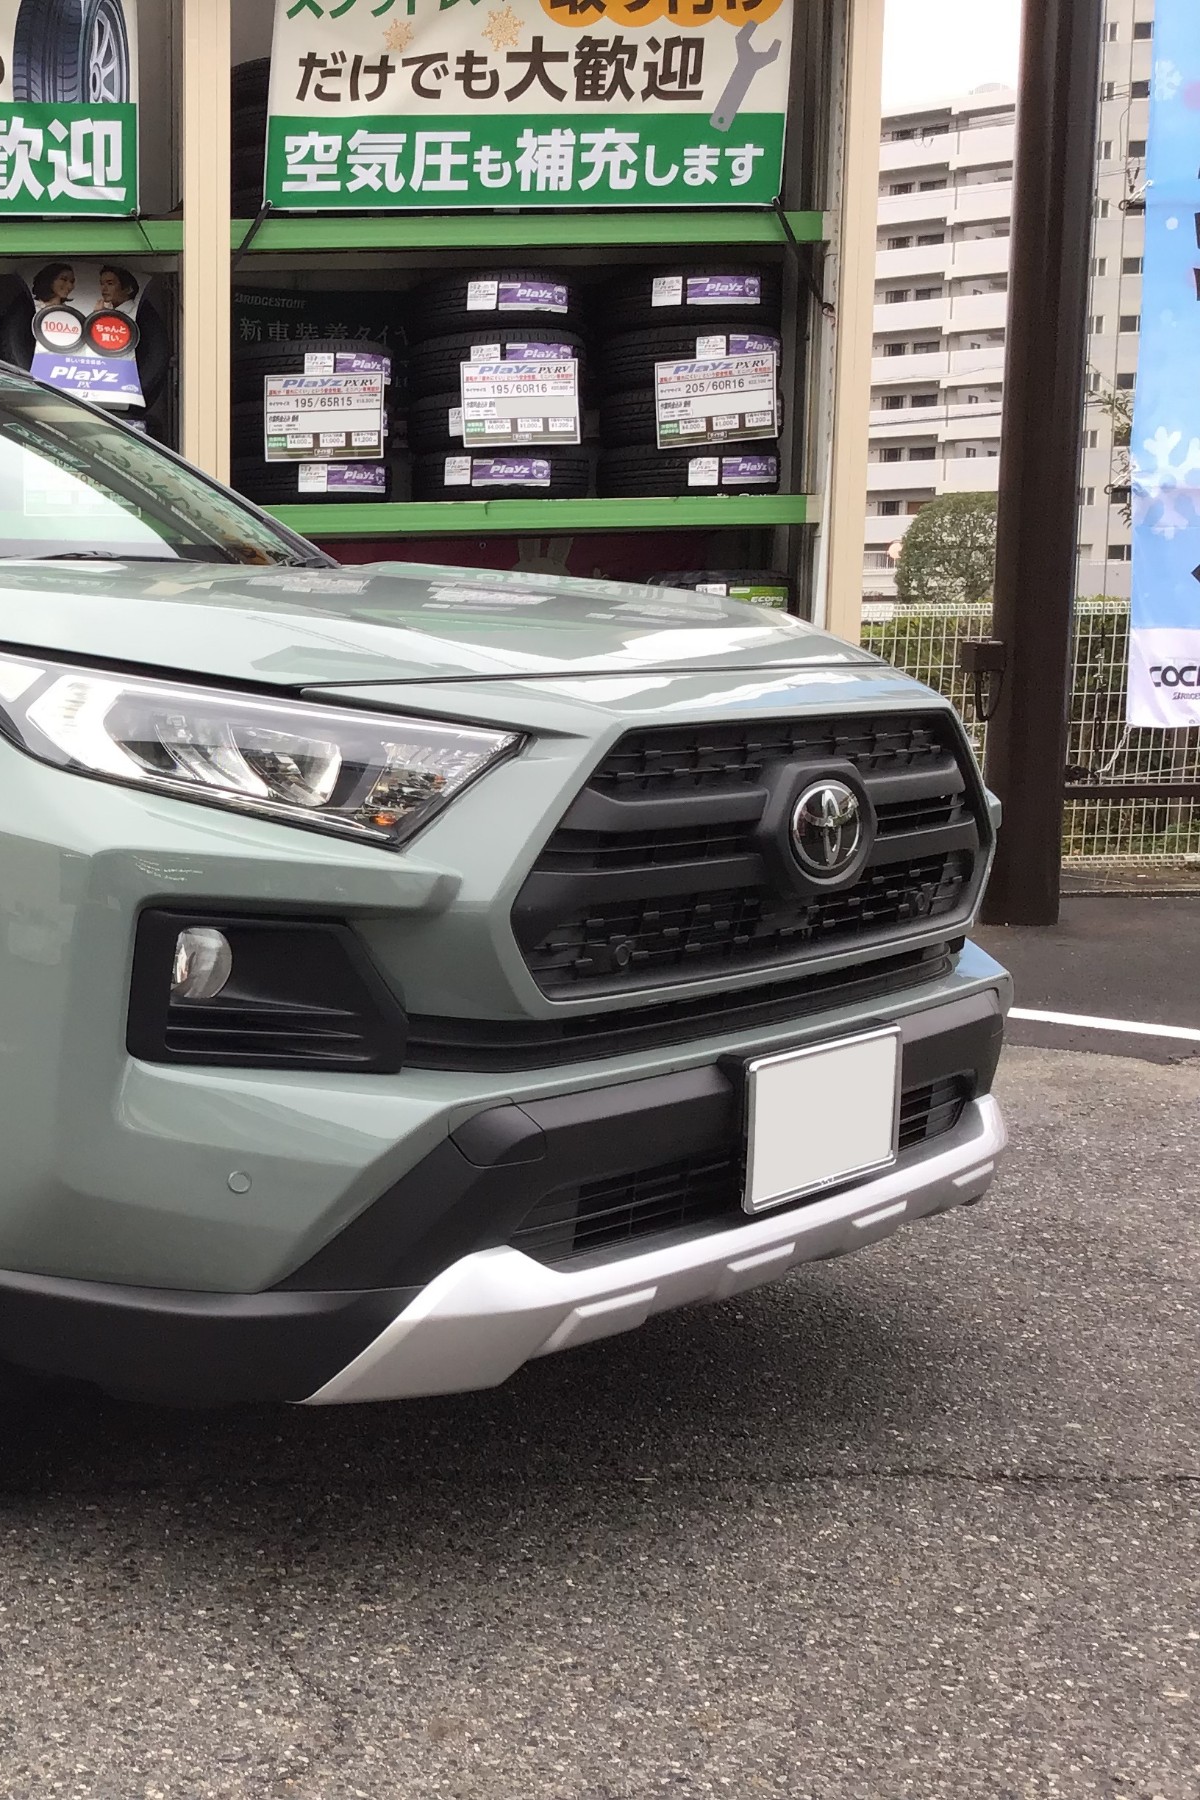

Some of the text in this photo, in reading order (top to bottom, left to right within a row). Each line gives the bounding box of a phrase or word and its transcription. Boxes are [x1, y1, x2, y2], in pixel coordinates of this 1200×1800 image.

[296, 34, 706, 103] だけでも大歓迎
[281, 126, 765, 194] 空気圧も補充します
[704, 282, 744, 293] Playz
[516, 288, 553, 299] Playz
[43, 320, 80, 333] 100人の
[95, 324, 128, 334] ちゃんと
[352, 360, 382, 371] Playz
[478, 365, 571, 375] Playz PX RV
[673, 359, 769, 375] Playz PX RV
[50, 365, 119, 383] Playz
[282, 378, 377, 388] Playz PX RV
[685, 378, 745, 394] 205/60R16
[491, 383, 548, 395] 195/60R16
[294, 396, 353, 408] 195/65R15
[489, 464, 530, 475] Playz
[739, 462, 768, 472] Playz
[344, 470, 375, 480] Playz
